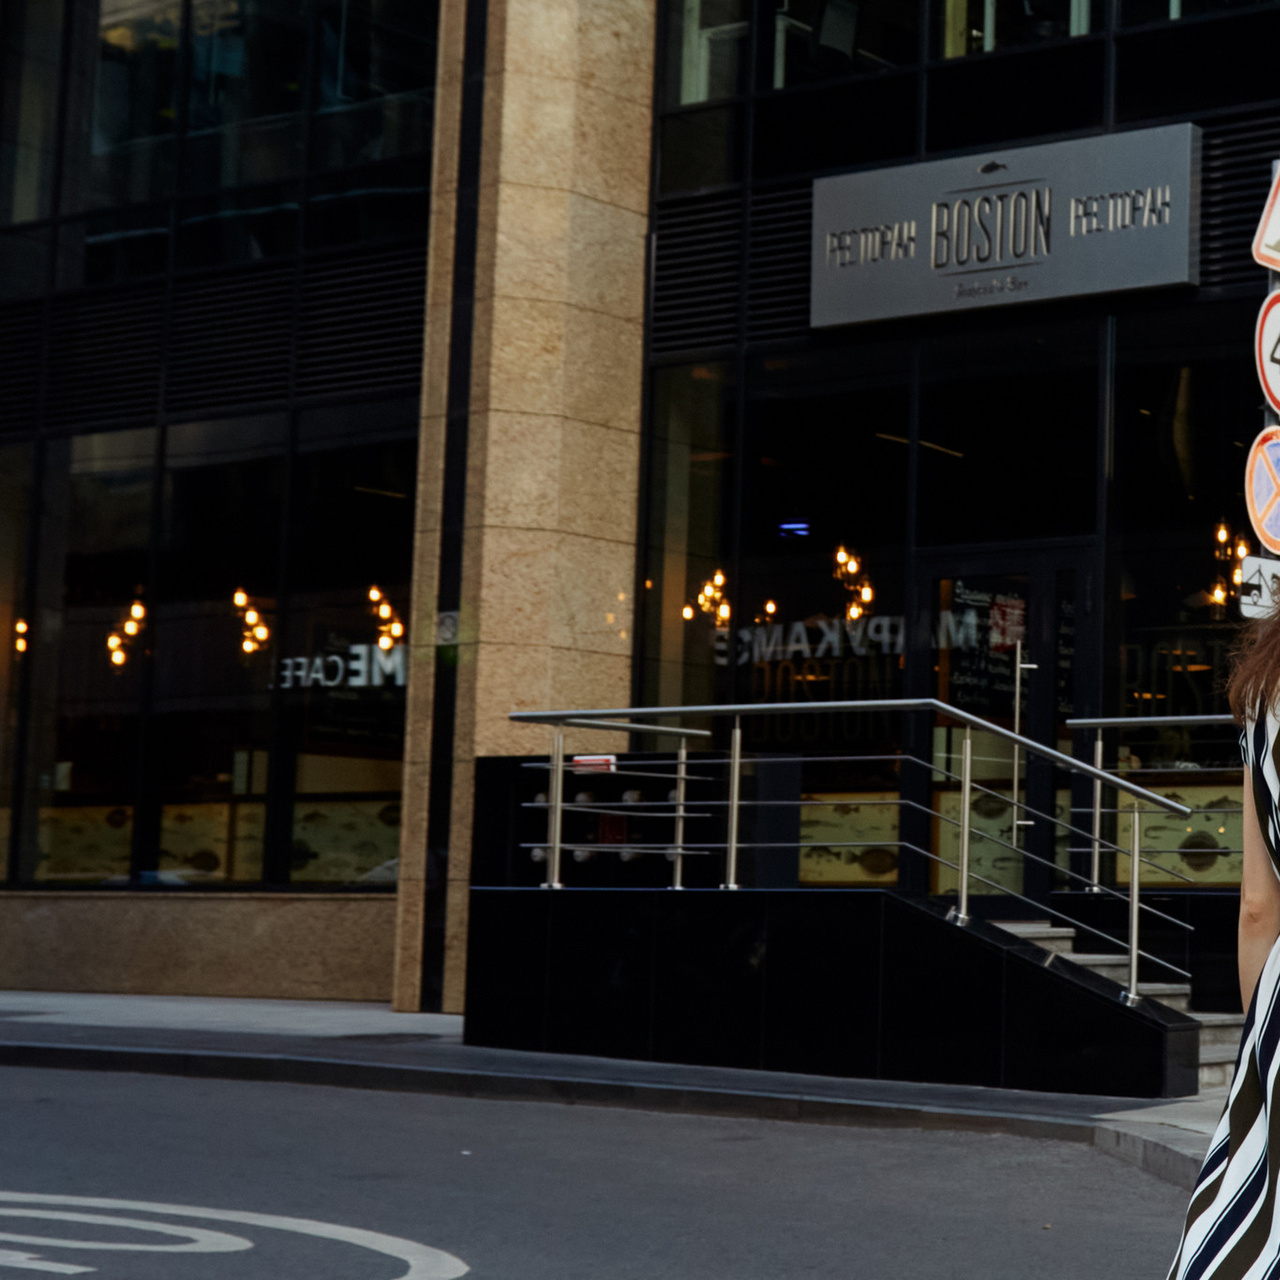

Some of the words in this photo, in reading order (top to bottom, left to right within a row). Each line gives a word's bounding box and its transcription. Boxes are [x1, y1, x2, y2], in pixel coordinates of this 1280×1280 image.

[930, 186, 1053, 270] BOSTON
[1069, 185, 1171, 237] РЕСТОРАН
[825, 220, 917, 269] РЕСТОРАН
